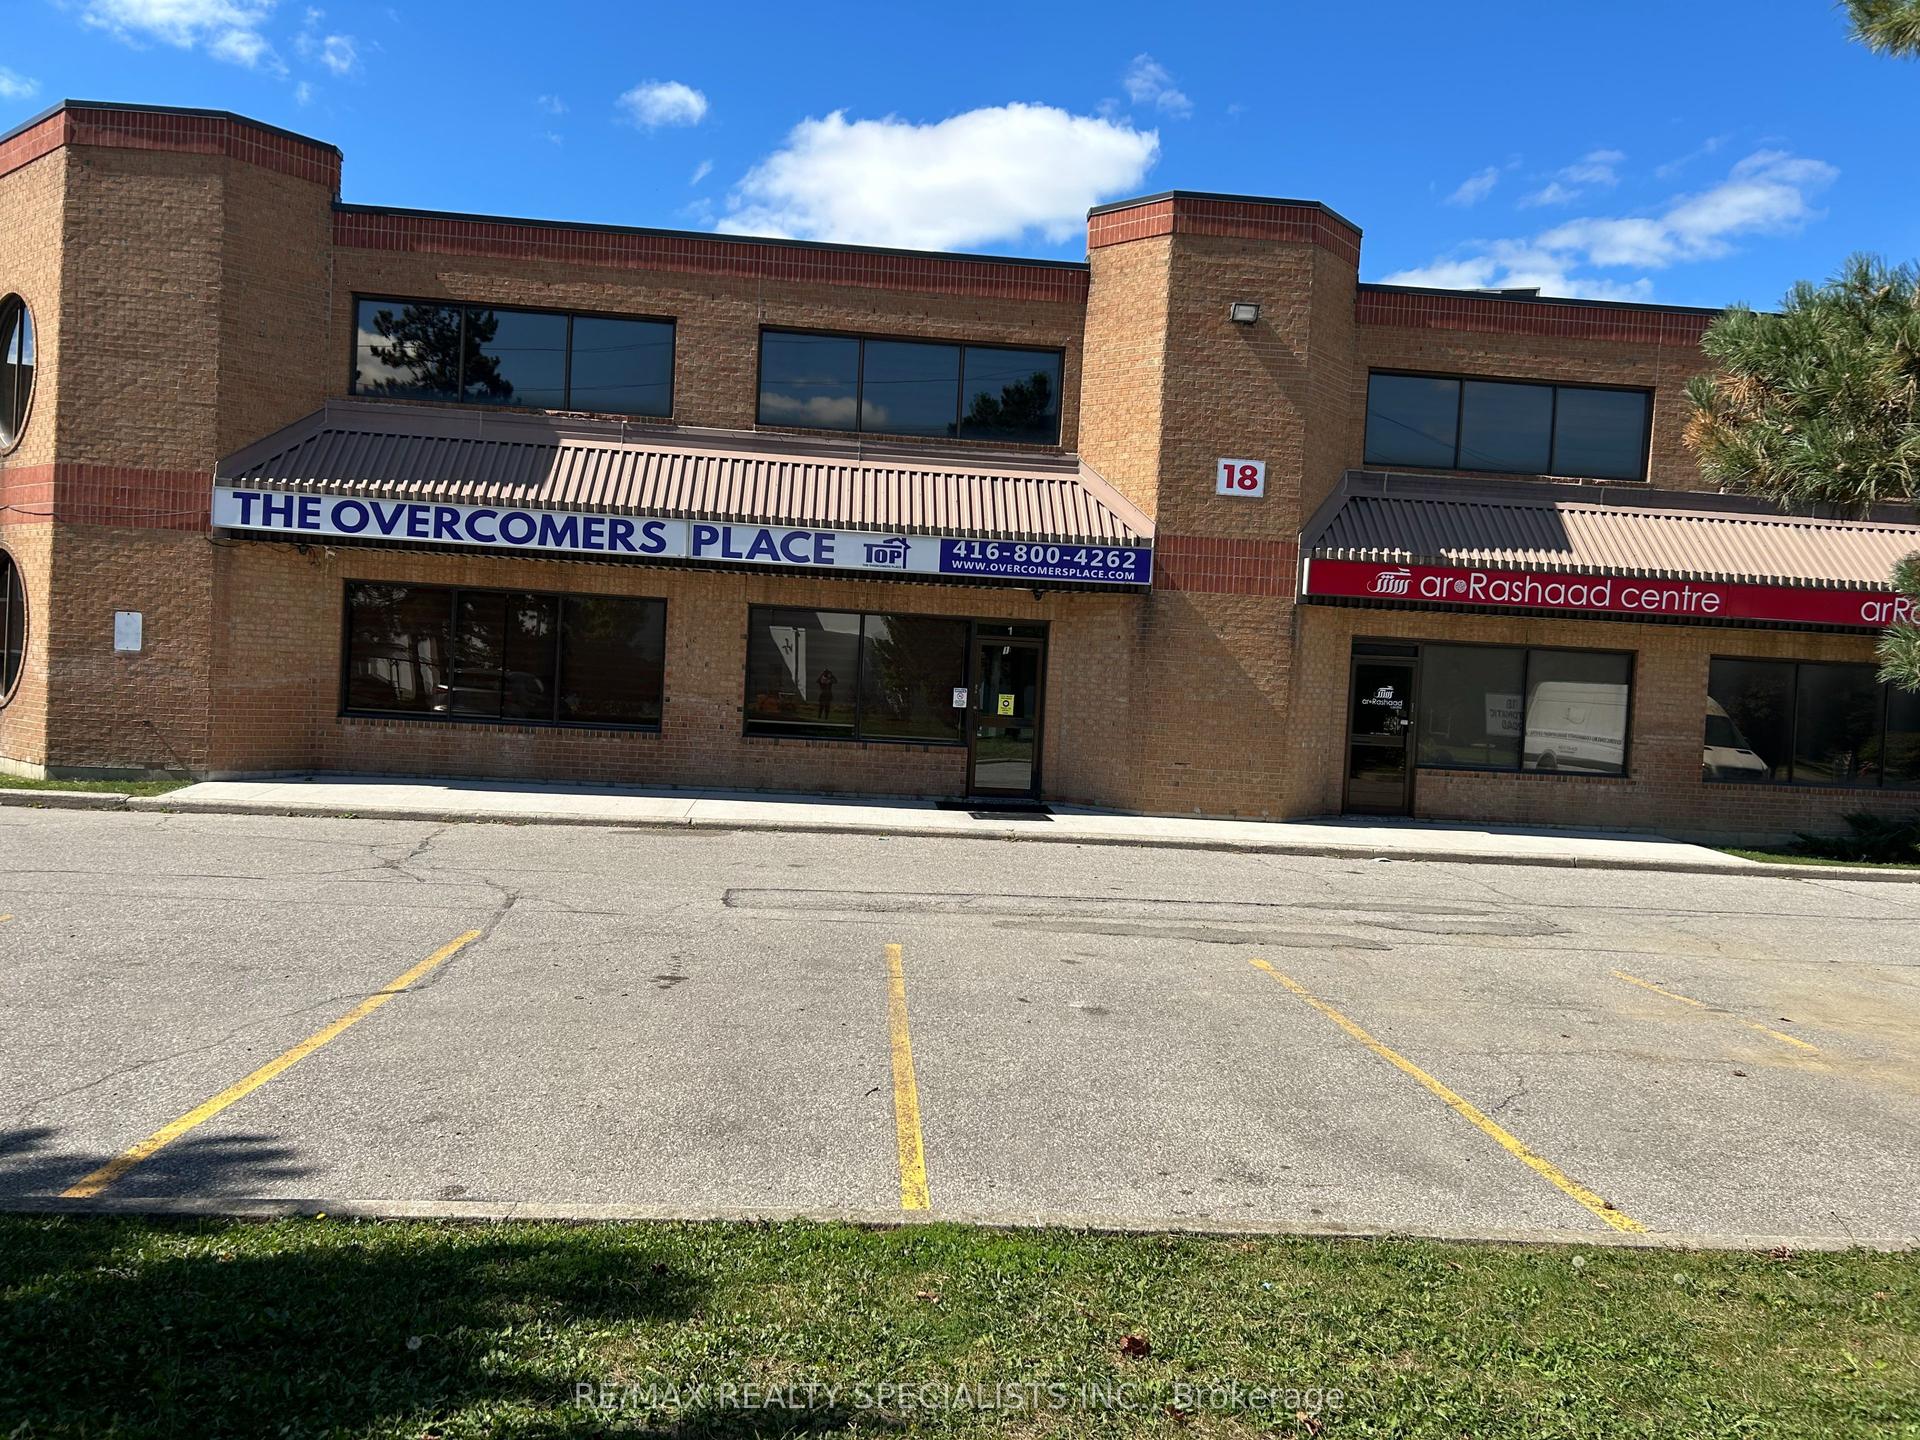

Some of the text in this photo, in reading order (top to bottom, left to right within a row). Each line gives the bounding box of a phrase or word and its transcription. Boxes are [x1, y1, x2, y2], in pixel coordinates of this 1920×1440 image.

[1223, 464, 1259, 490] 18
[232, 491, 836, 565] THE OVERCOMERS PLACE
[863, 543, 902, 564] TOP
[952, 540, 1137, 569] 416-800-4262
[951, 559, 1136, 581] WWW.OVERCOMERSPLACE.COM
[1620, 584, 1720, 613] centre
